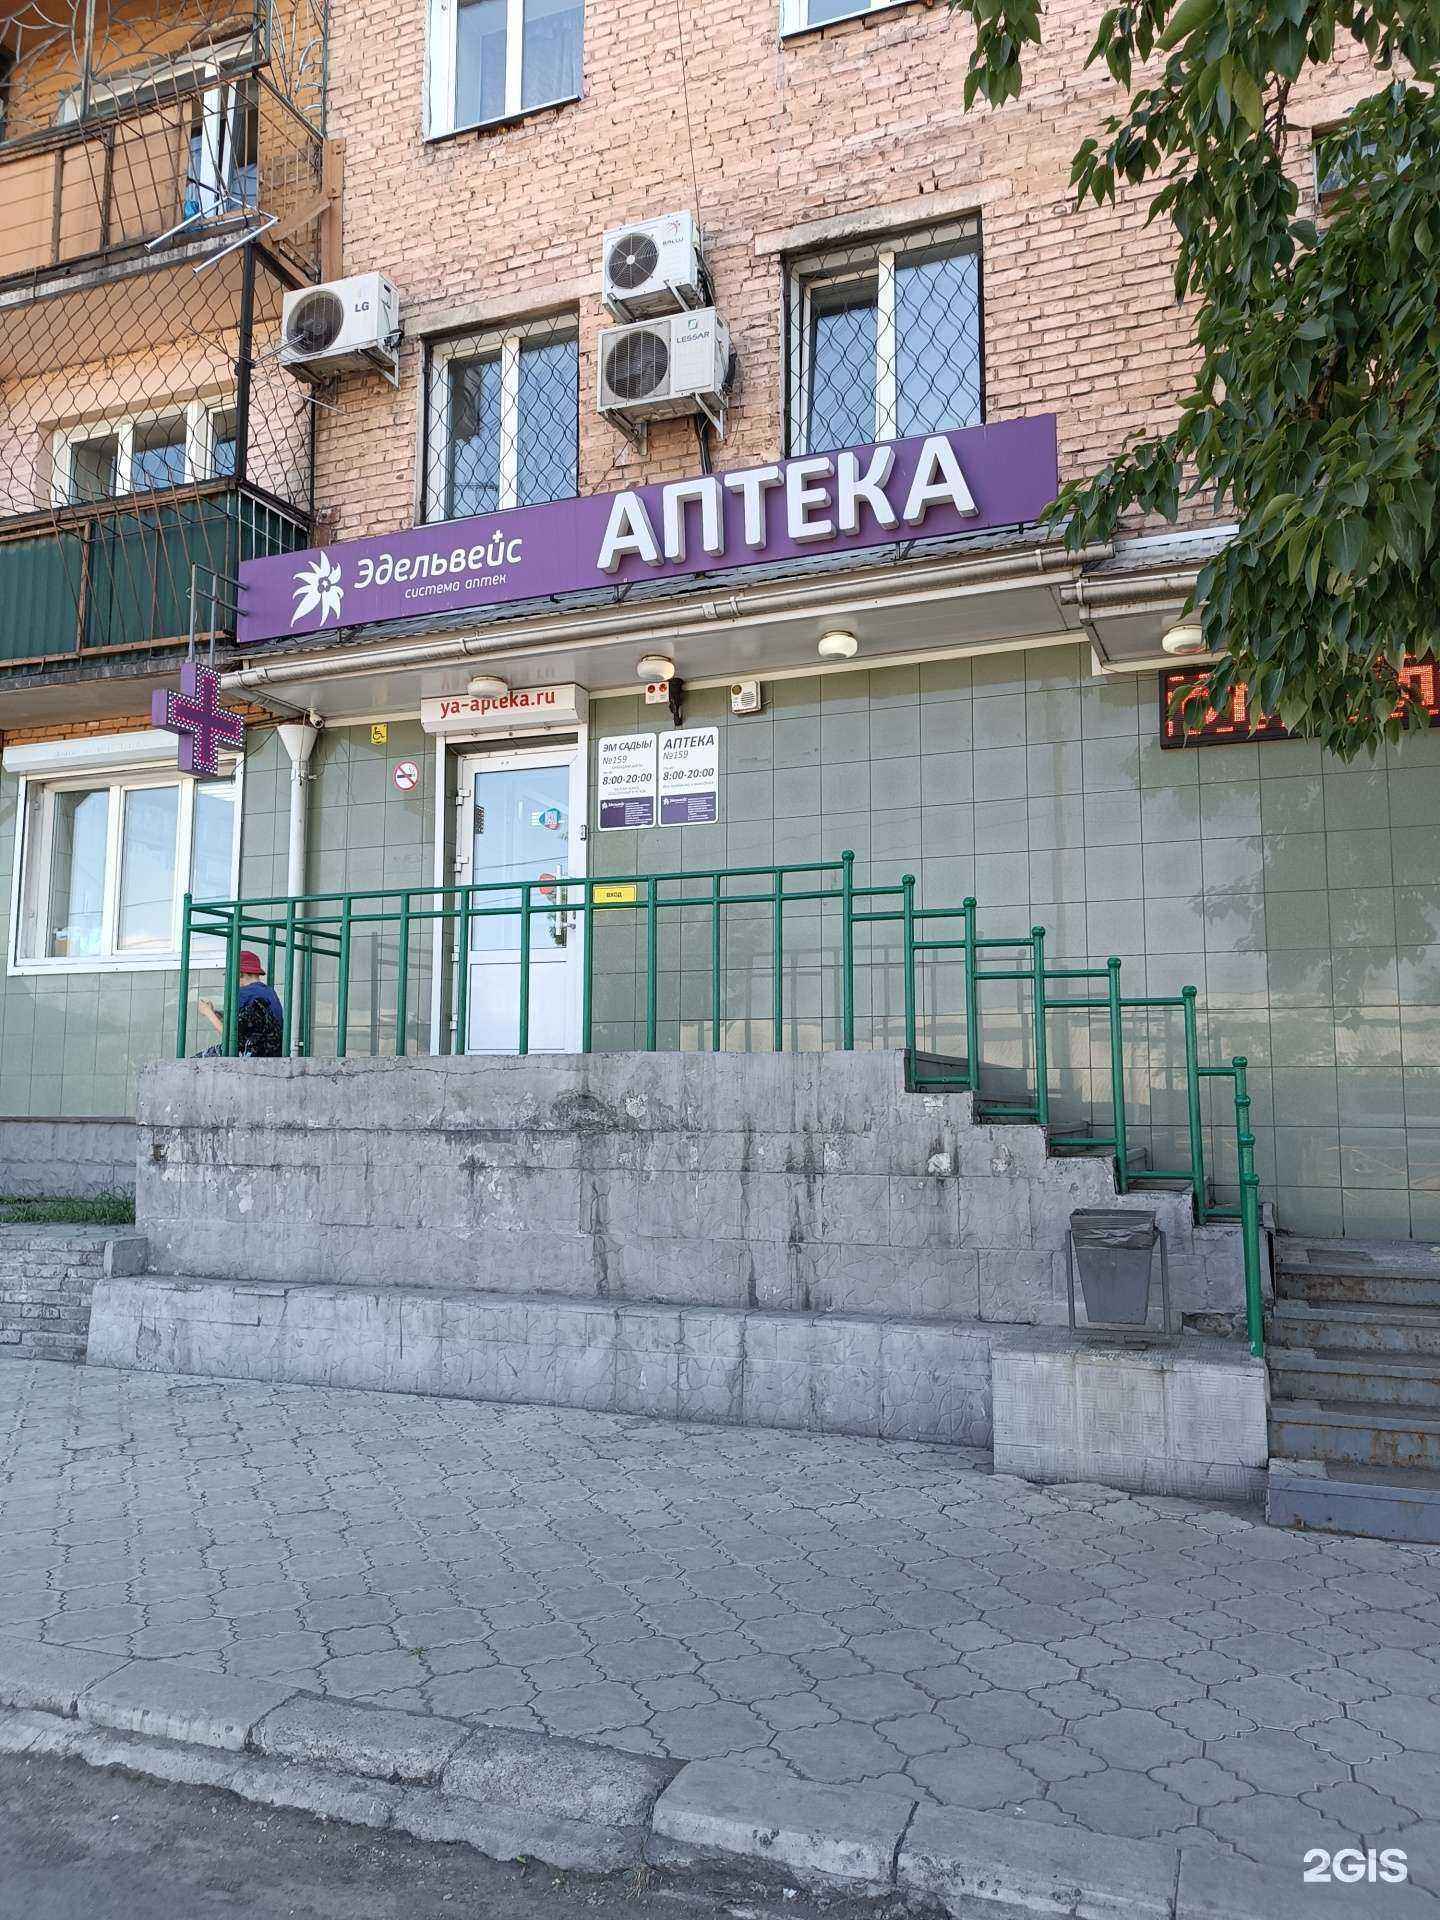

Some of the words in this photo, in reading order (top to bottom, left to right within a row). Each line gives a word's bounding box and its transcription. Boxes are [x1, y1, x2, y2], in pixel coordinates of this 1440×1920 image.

[354, 301, 370, 313] LG
[676, 331, 710, 344] LESSAR
[596, 435, 979, 574] АПТЕКА
[353, 530, 523, 589] Эдельвейс
[404, 581, 460, 599] система
[465, 574, 507, 590] аптек
[440, 690, 556, 719] ya-apteka.ru
[602, 743, 617, 752] ЭМ
[663, 734, 715, 751] АПТЕКА
[602, 755, 628, 765] №159
[663, 750, 689, 760] №159
[602, 772, 652, 785] 8:00-20:00
[663, 767, 715, 781] 8:00-20:00
